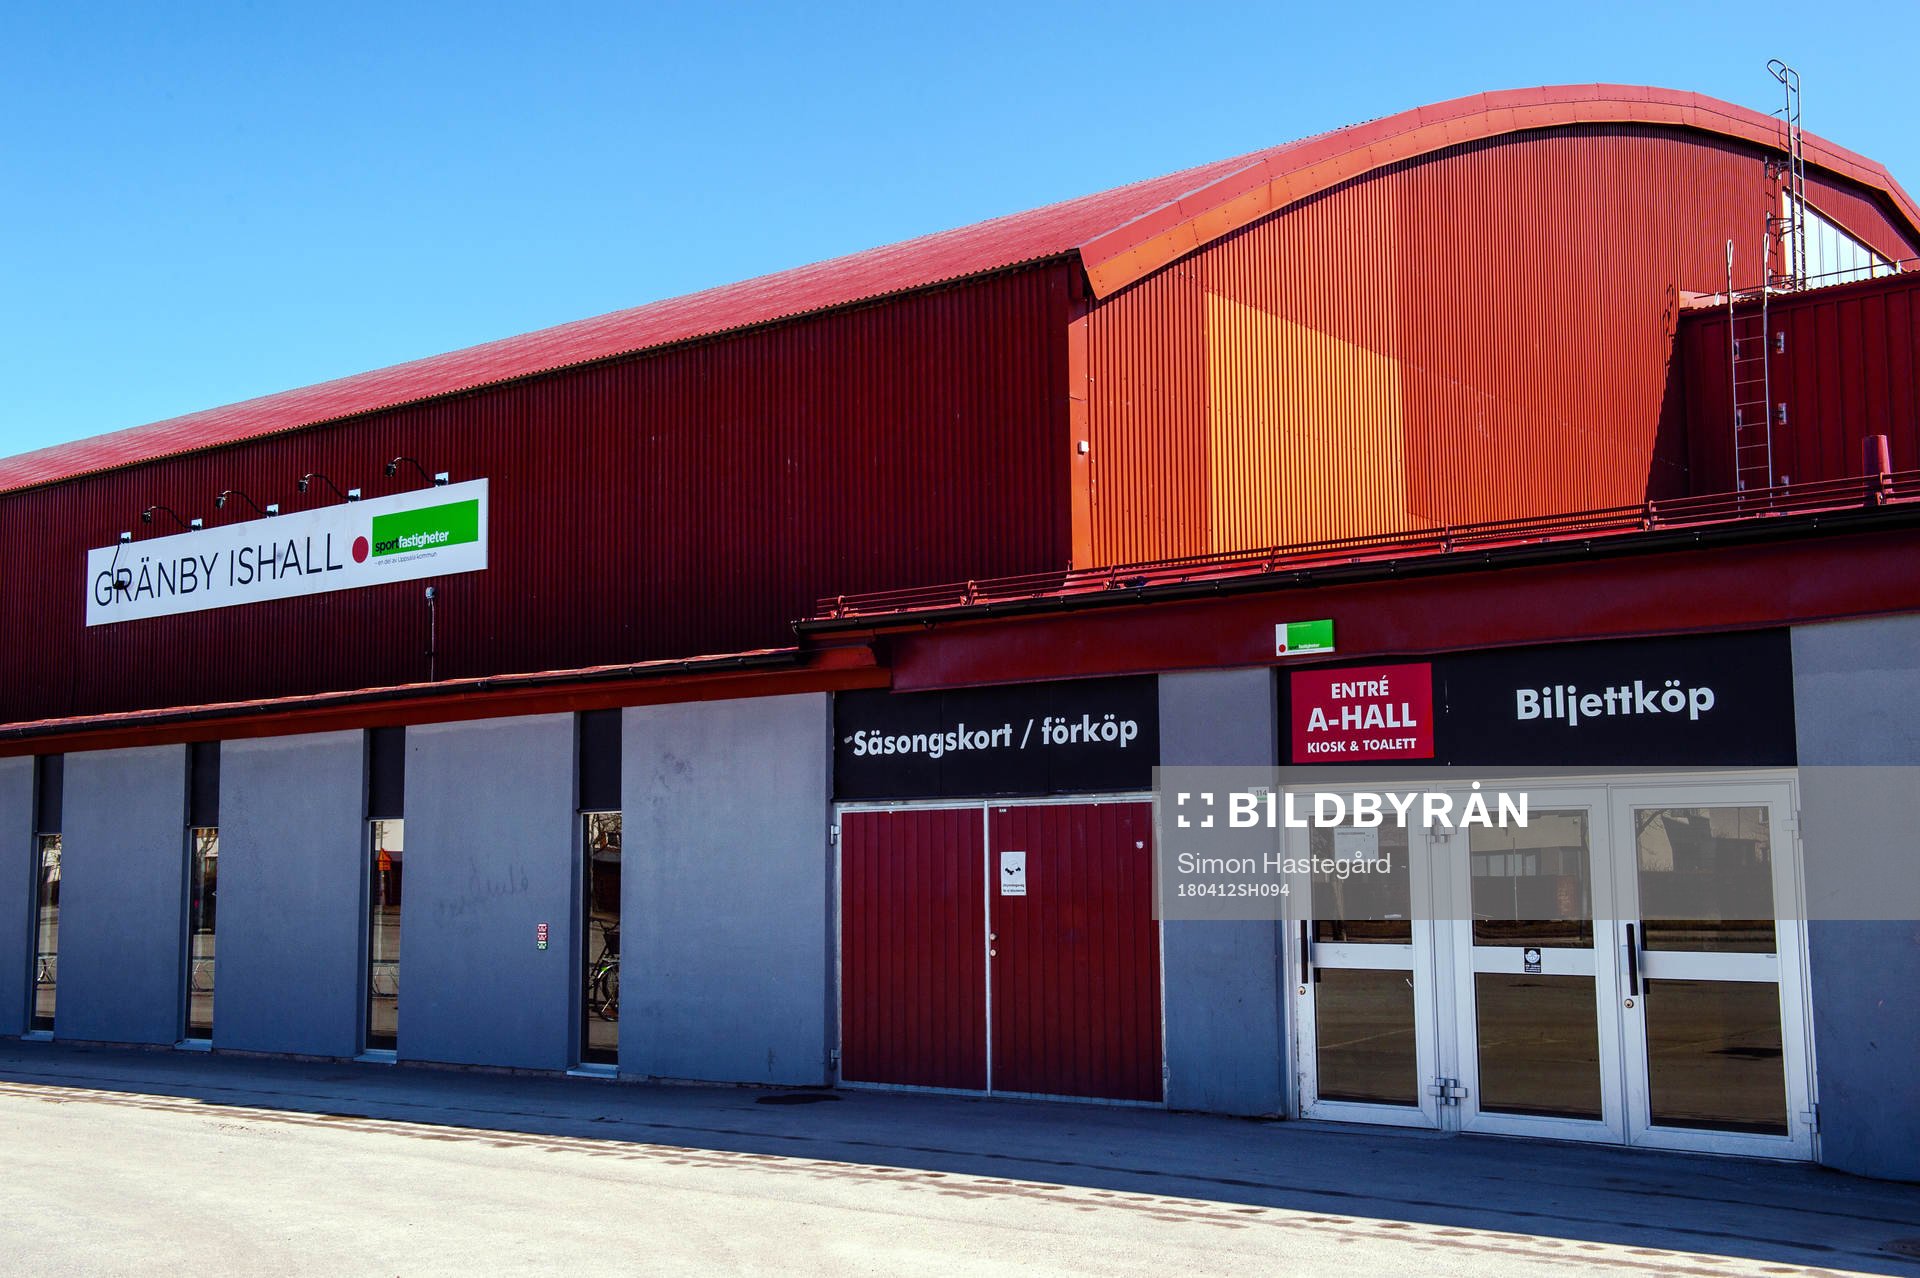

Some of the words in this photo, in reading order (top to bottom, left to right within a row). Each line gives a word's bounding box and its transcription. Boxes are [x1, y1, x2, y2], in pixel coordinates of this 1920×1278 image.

[375, 531, 449, 553] sportfastigheter
[95, 552, 219, 606] GRÄNBY
[229, 533, 343, 587] ISHALL
[1331, 675, 1389, 699] ENTRÉ
[1516, 680, 1715, 726] Biljettköp
[1307, 702, 1417, 732] A-HALL
[853, 723, 1013, 758] Säsongskort
[1020, 719, 1034, 749] /
[1041, 714, 1138, 747] förköp
[1307, 741, 1346, 753] KIOSK
[1350, 740, 1359, 752] &
[1363, 738, 1417, 751] TOALETT
[1256, 789, 1267, 797] 114
